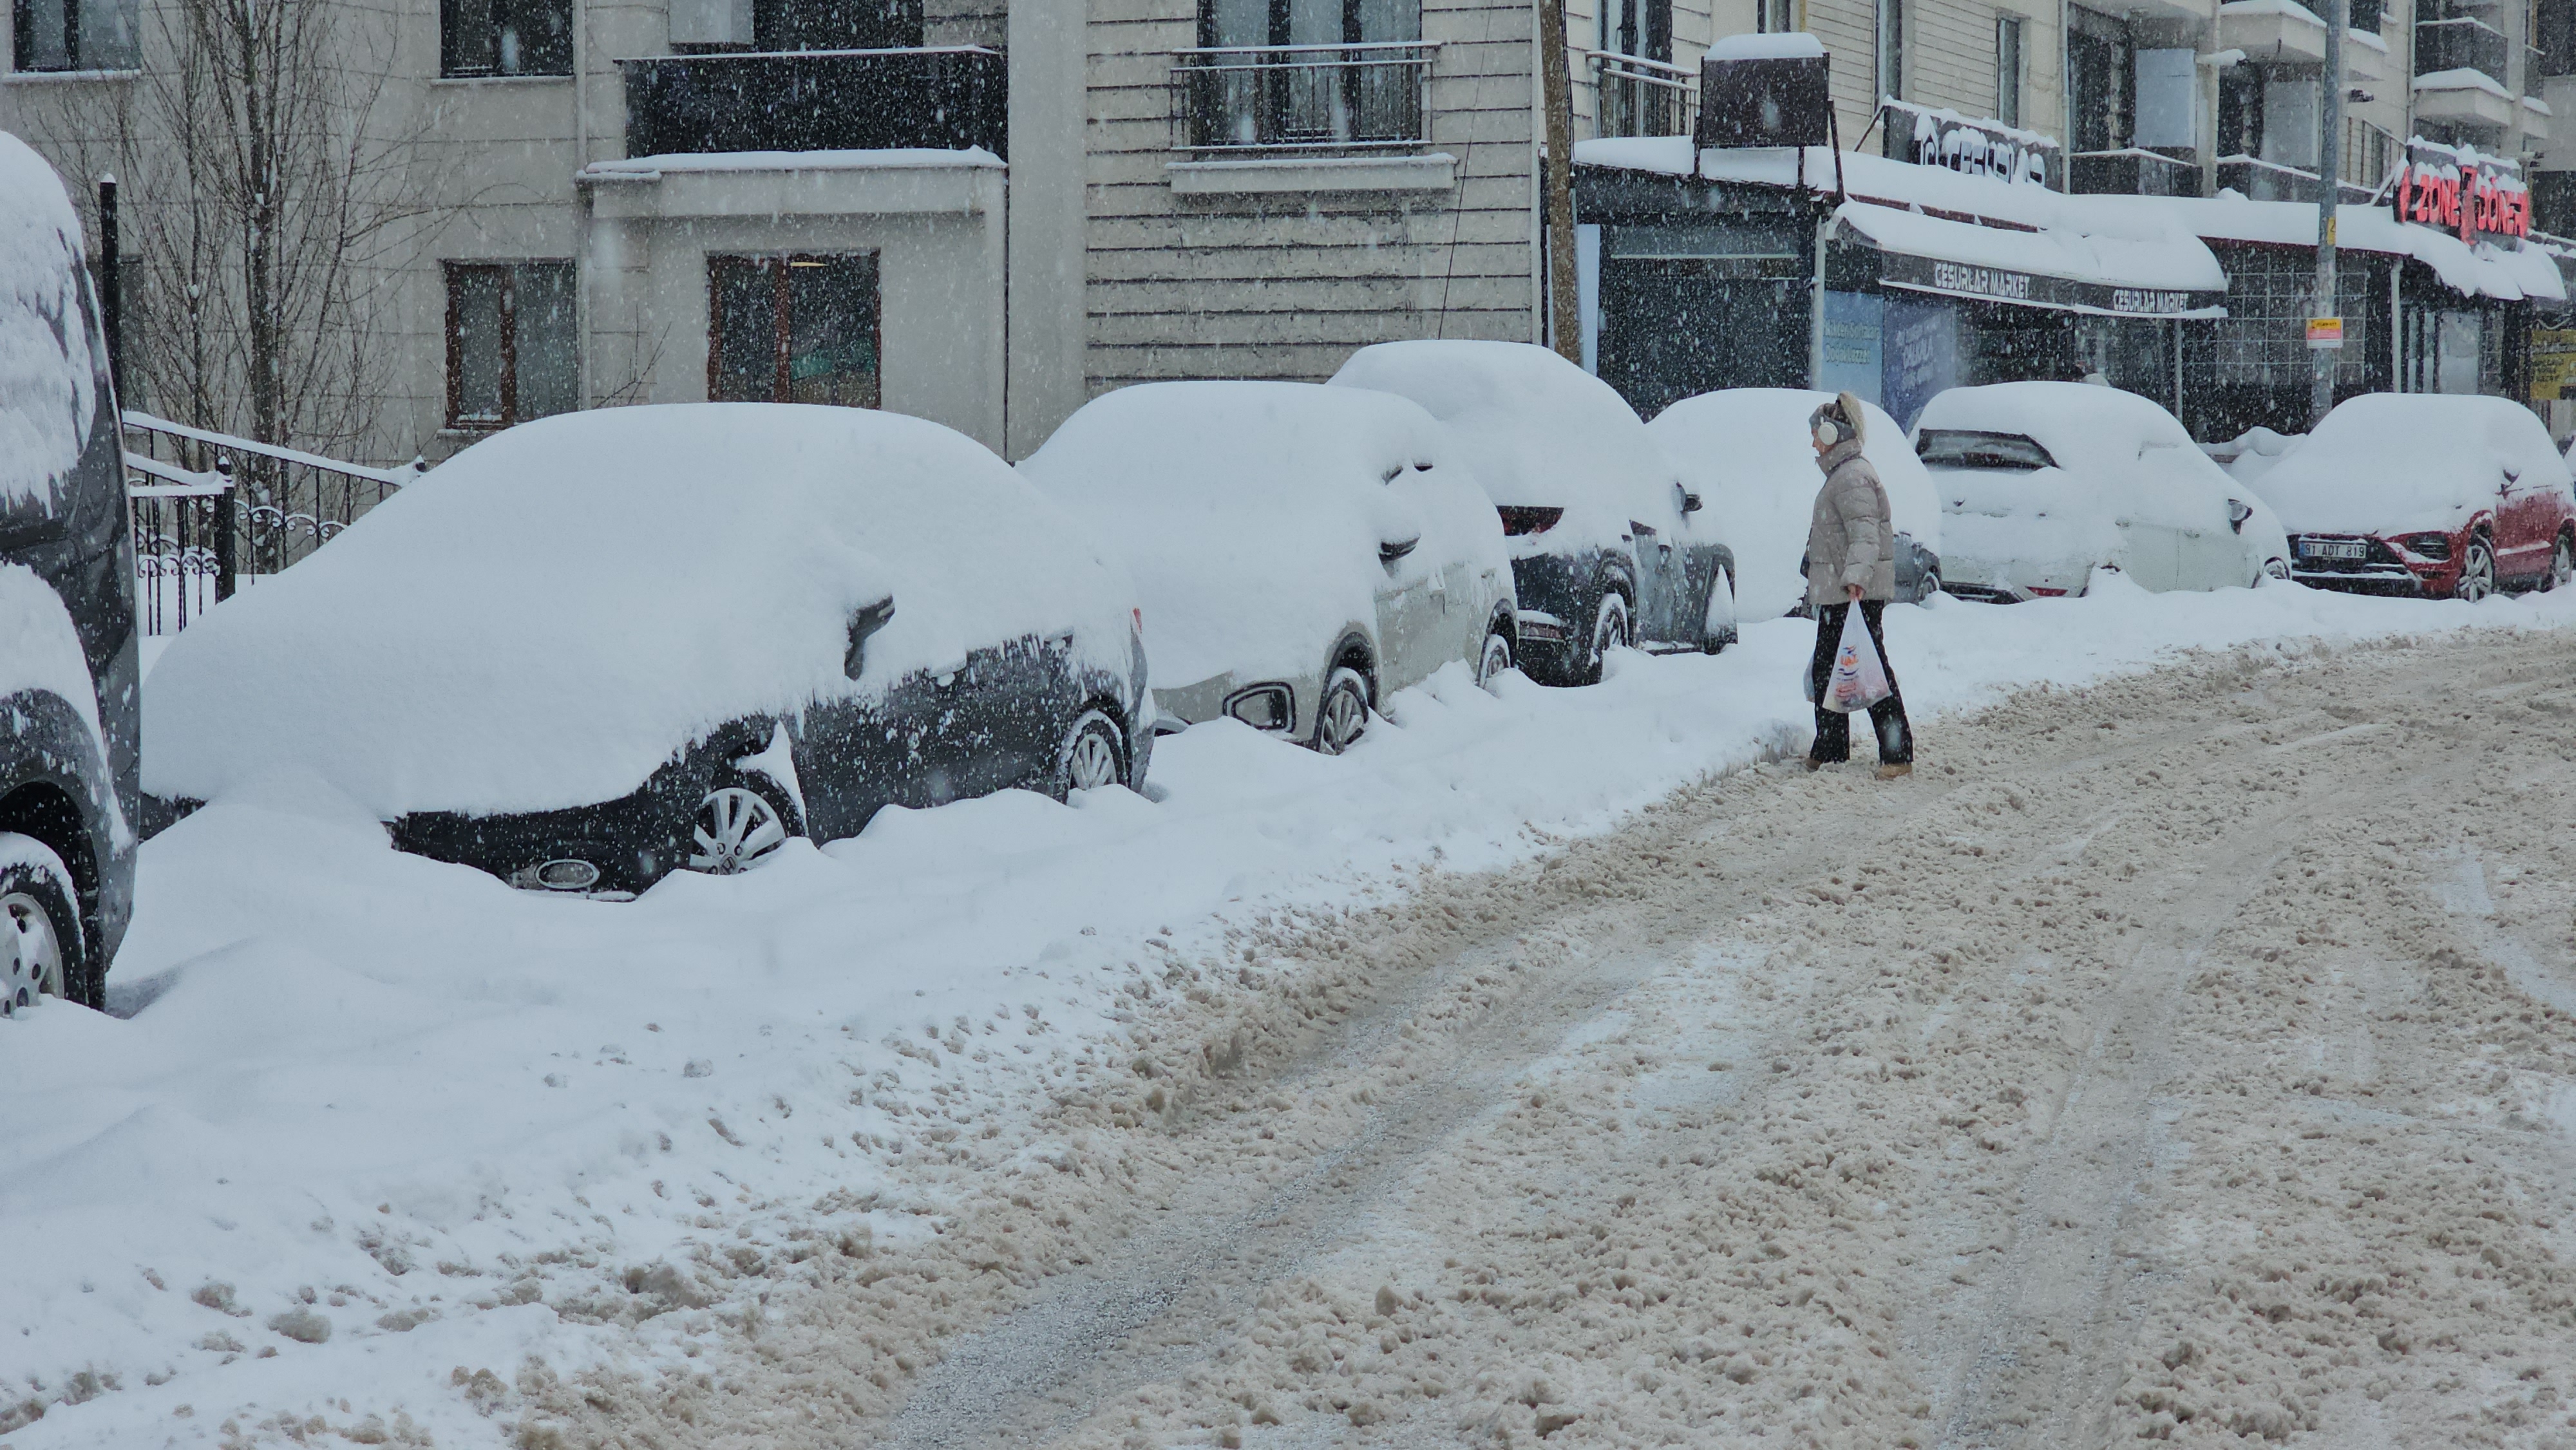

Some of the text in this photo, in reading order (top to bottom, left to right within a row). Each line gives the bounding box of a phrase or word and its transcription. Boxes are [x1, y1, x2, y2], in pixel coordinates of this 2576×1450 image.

[1935, 263, 2031, 299] CESURLAR MARKET
[2113, 289, 2189, 313] CESURLAR MARKET
[2322, 545, 2340, 556] ADT
[2346, 545, 2365, 557] 819
